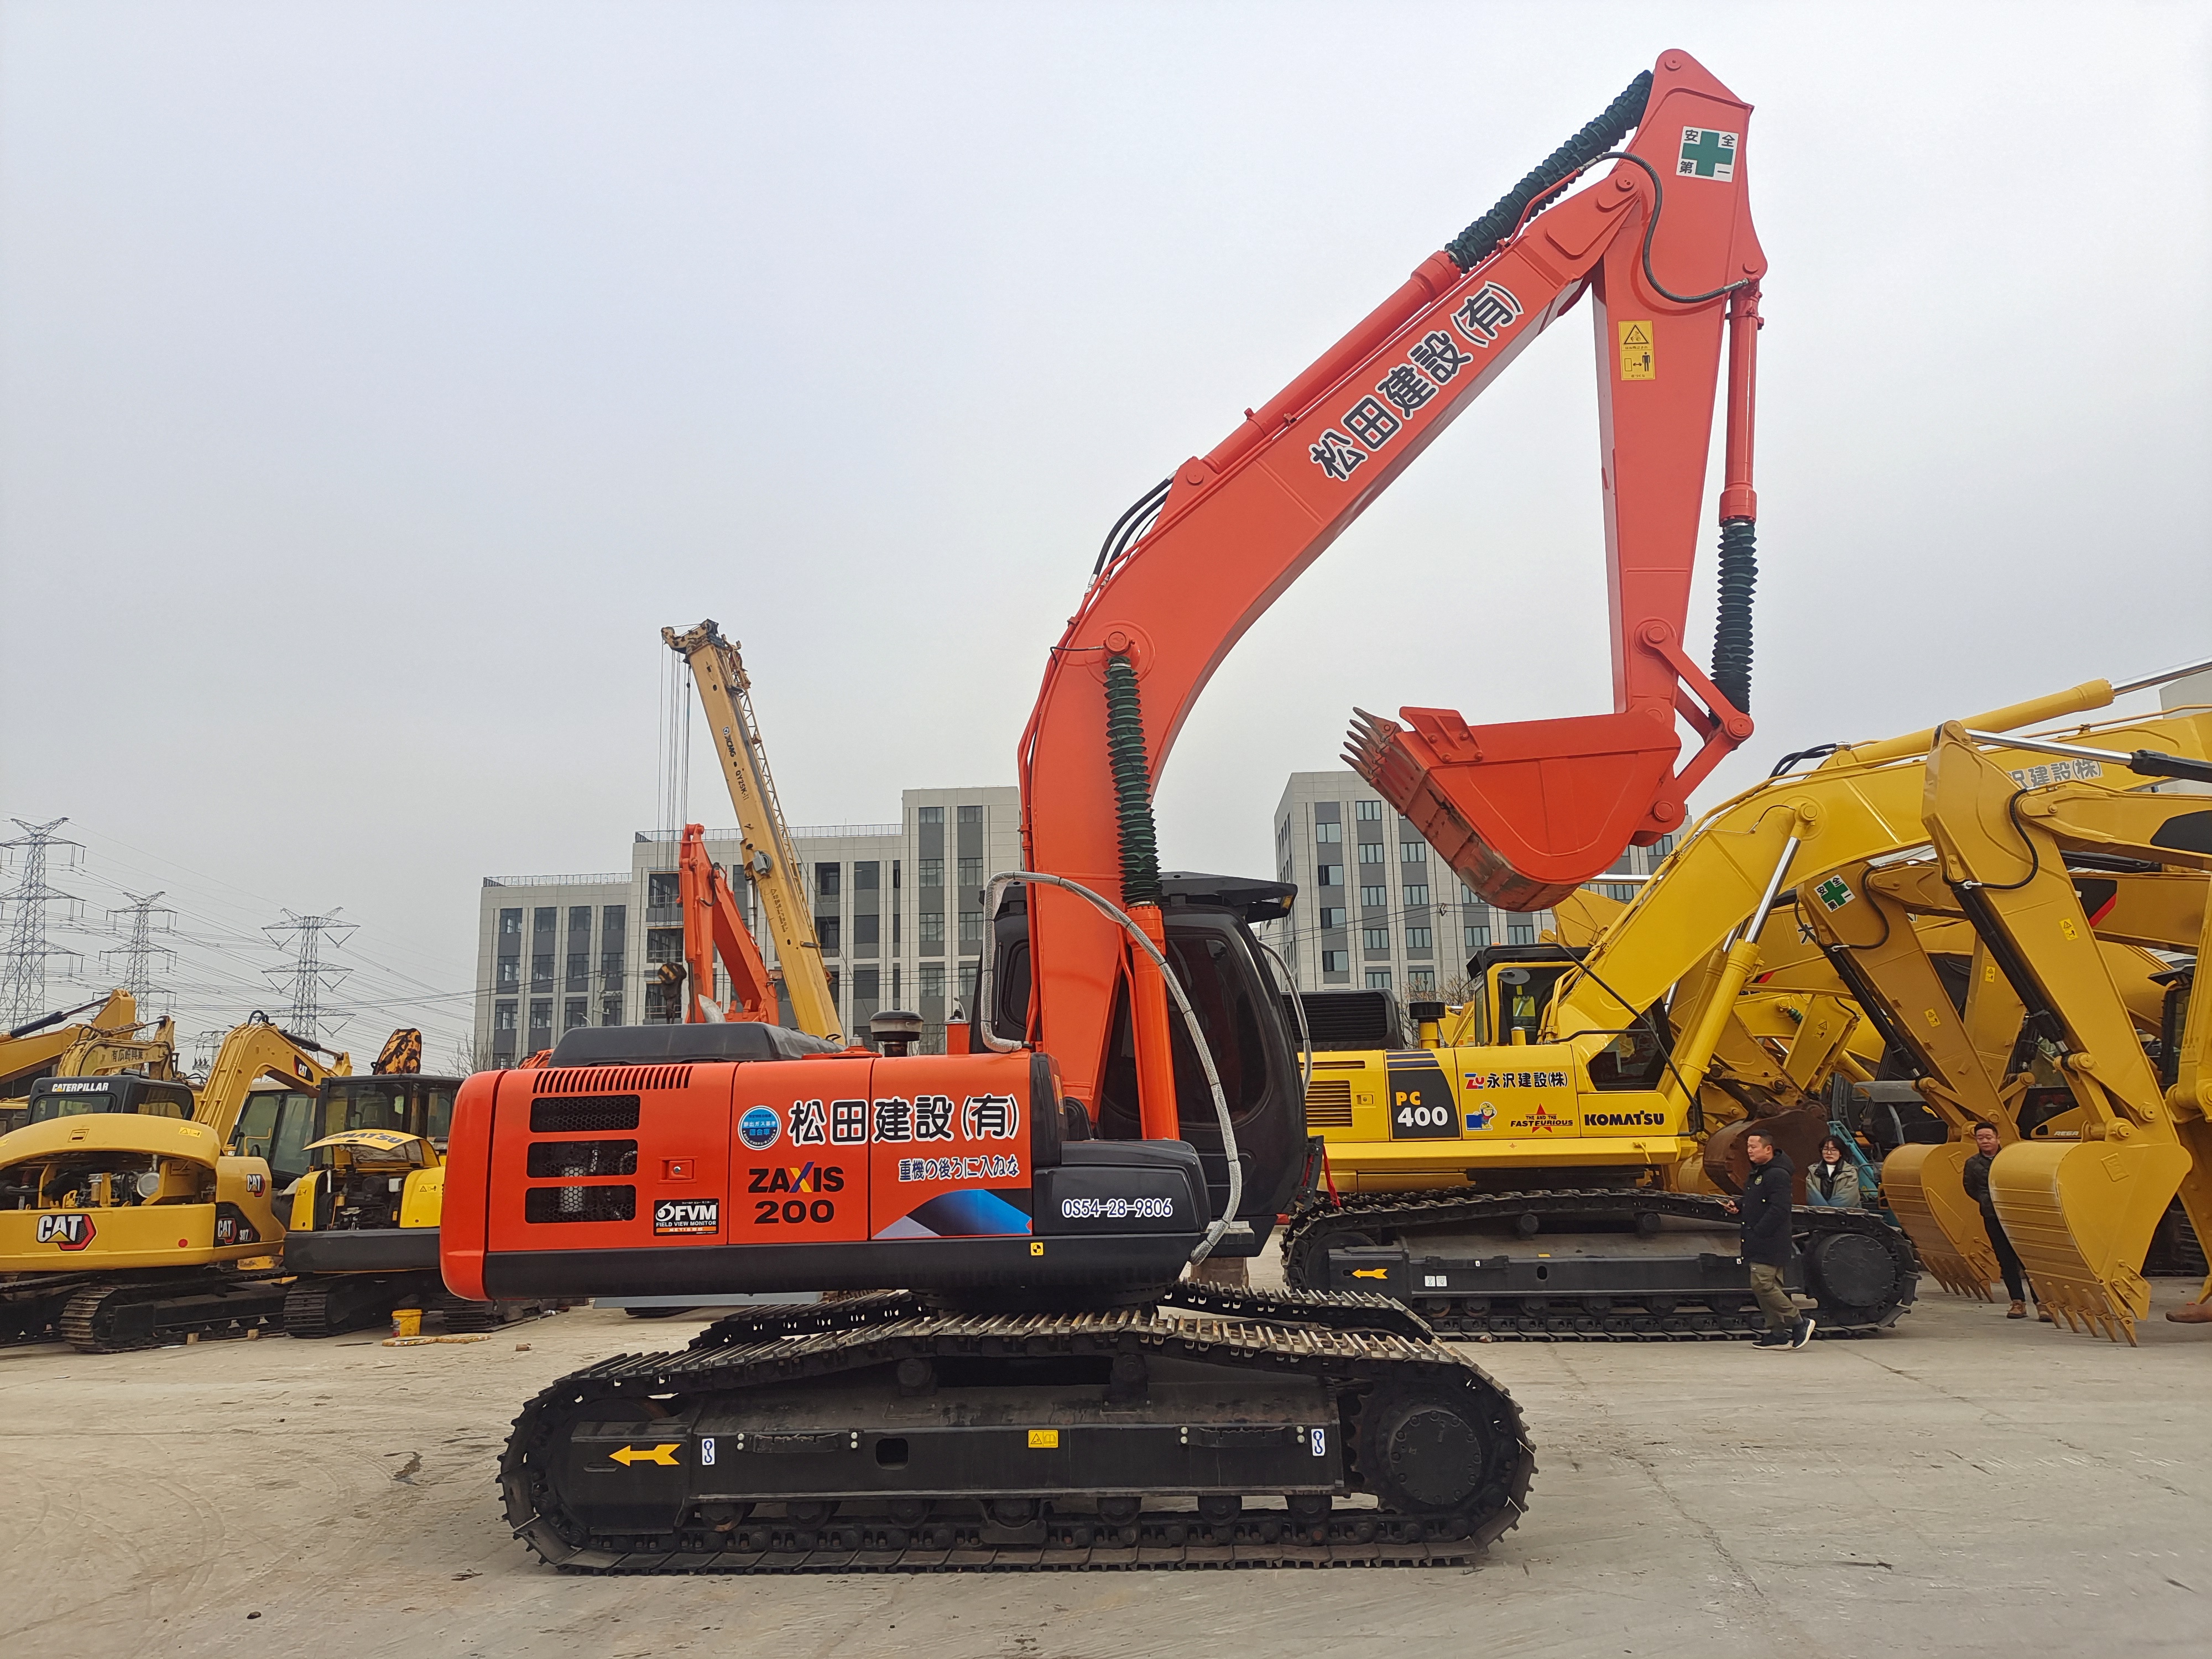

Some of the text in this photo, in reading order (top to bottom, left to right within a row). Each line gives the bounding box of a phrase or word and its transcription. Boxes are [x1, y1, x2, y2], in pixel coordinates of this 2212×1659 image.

[1311, 283, 1522, 481] 松田建設(有)
[298, 1063, 307, 1077] CAT
[51, 1083, 109, 1092] CATERPILLAR
[1486, 1071, 1568, 1088] 永沢建設(株)
[1396, 1092, 1421, 1105] PC
[789, 1094, 1019, 1145] 松田建設(有)
[1397, 1107, 1448, 1126] 400
[1584, 1110, 1665, 1126] KOMATSU
[247, 1175, 260, 1191] CAT
[748, 1161, 844, 1193] ZAXIS
[675, 1204, 717, 1221] FVM
[754, 1199, 834, 1224] 200
[39, 1215, 82, 1243] CAT
[218, 1220, 232, 1238] CAT
